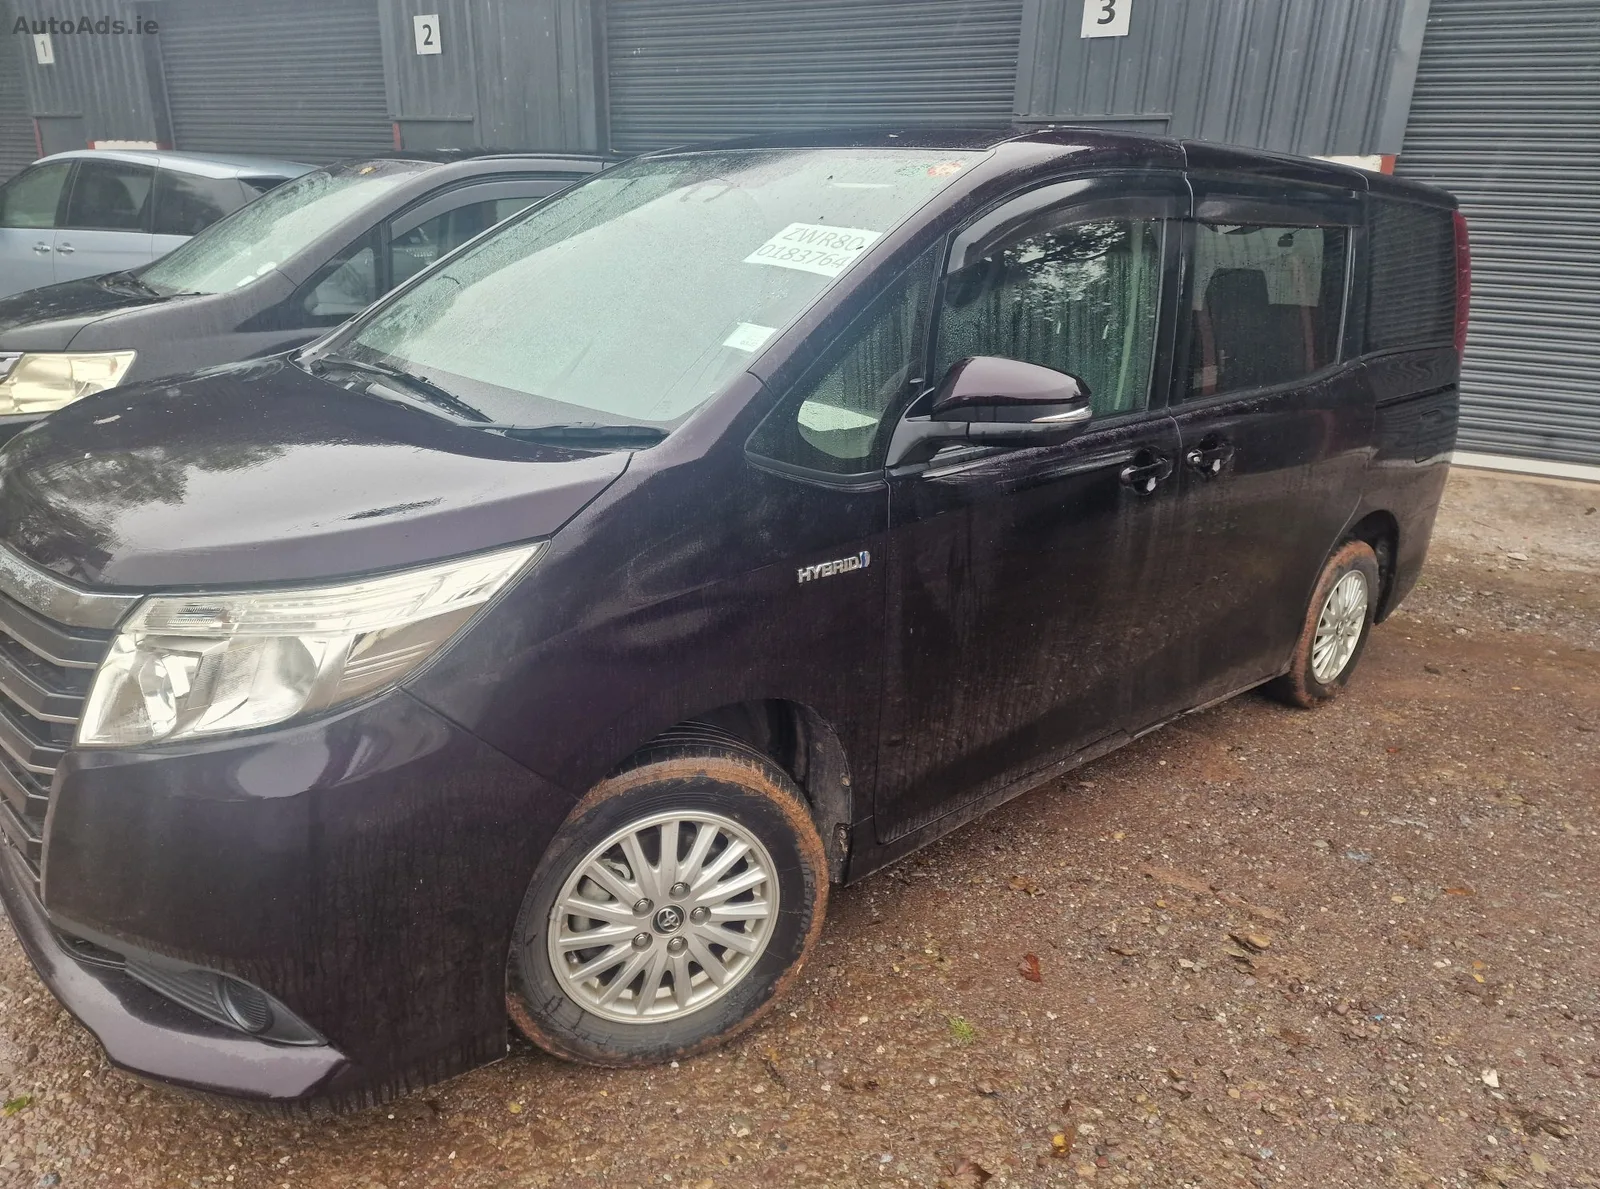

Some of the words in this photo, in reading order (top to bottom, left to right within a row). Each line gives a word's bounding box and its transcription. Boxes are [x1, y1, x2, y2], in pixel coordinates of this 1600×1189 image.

[1097, 0, 1116, 25] 3
[422, 24, 433, 46] 2
[40, 40, 48, 57] 1
[756, 243, 851, 269] 0183764
[798, 556, 861, 584] HYBRID
